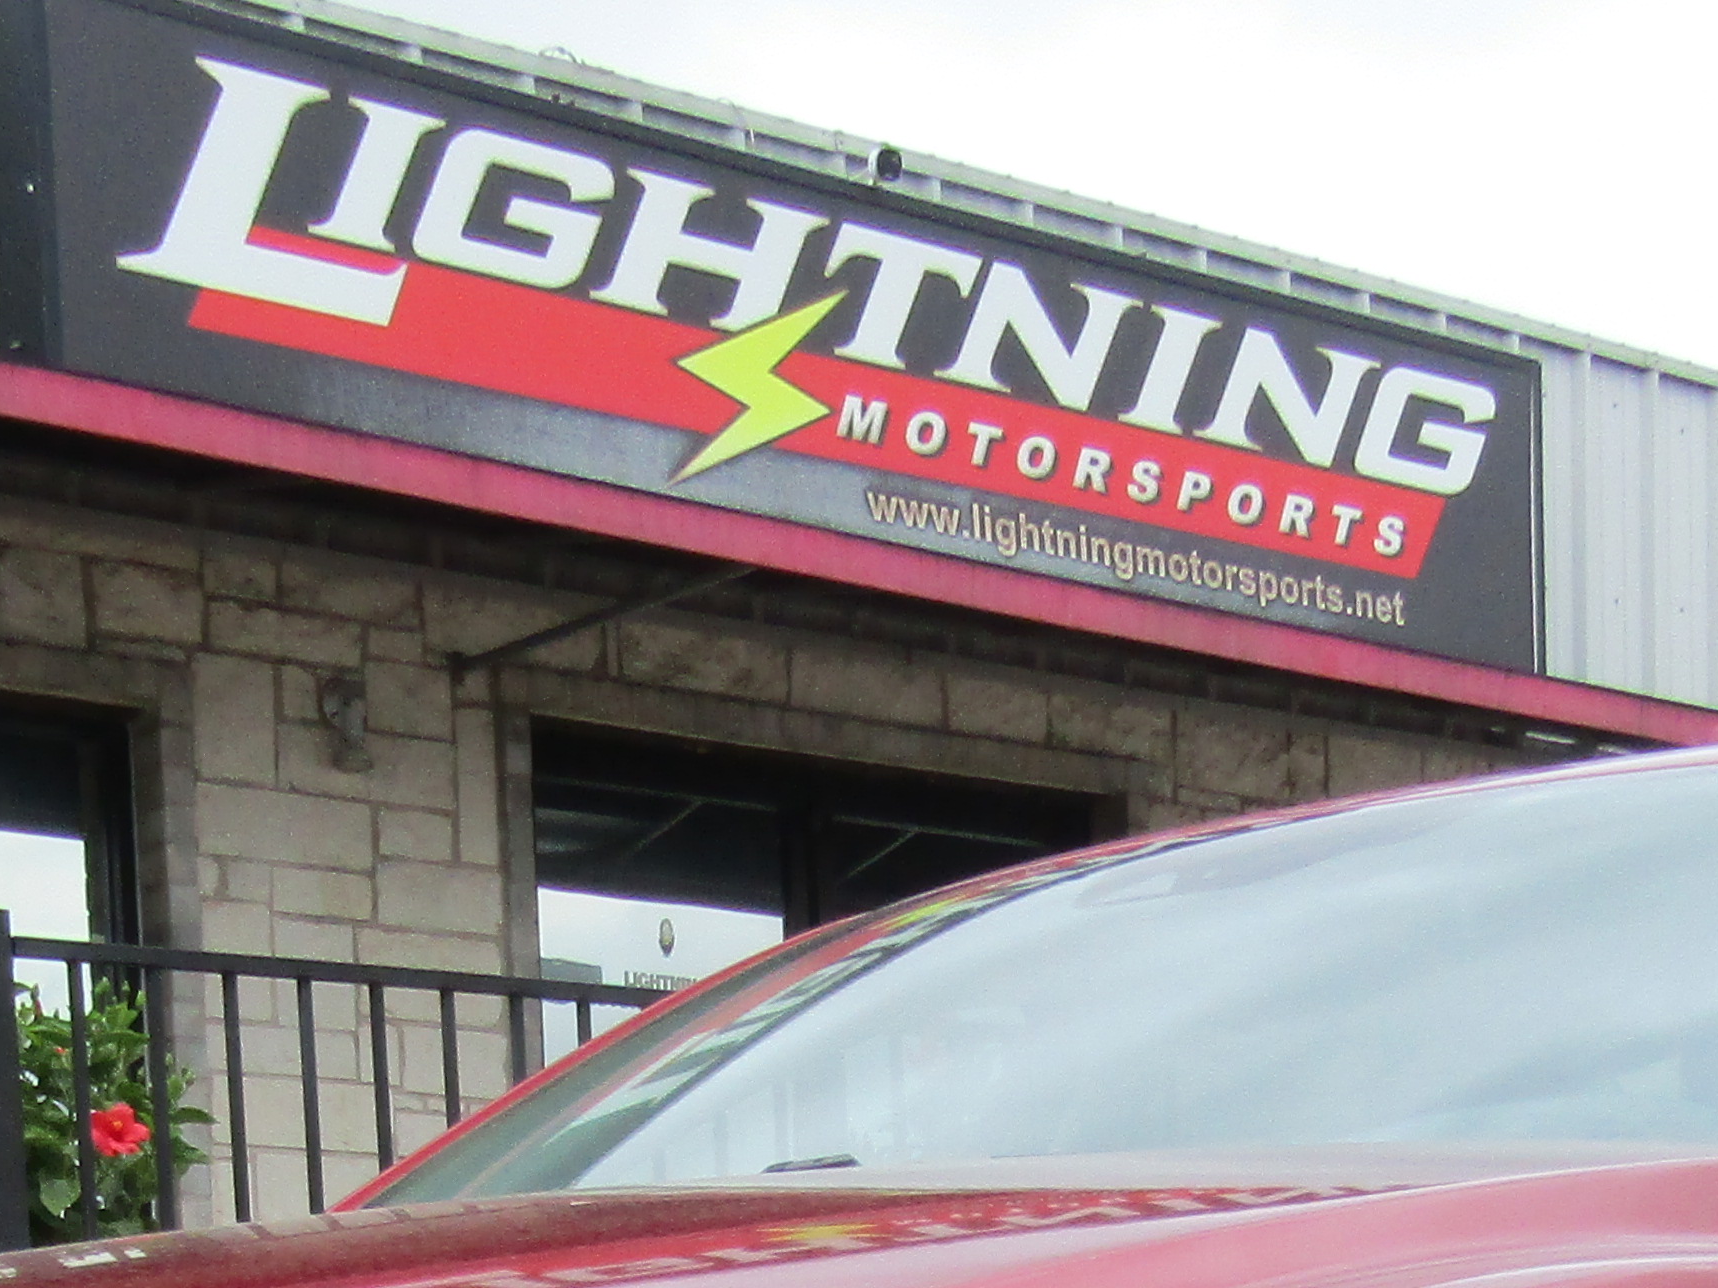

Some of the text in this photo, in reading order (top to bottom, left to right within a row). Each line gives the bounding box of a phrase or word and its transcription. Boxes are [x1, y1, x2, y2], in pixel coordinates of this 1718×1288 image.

[115, 55, 1496, 496] LIGHTNING
[835, 394, 1407, 557] MOTORSPORTS
[866, 491, 1406, 626] www.lightningmotorsports.net
